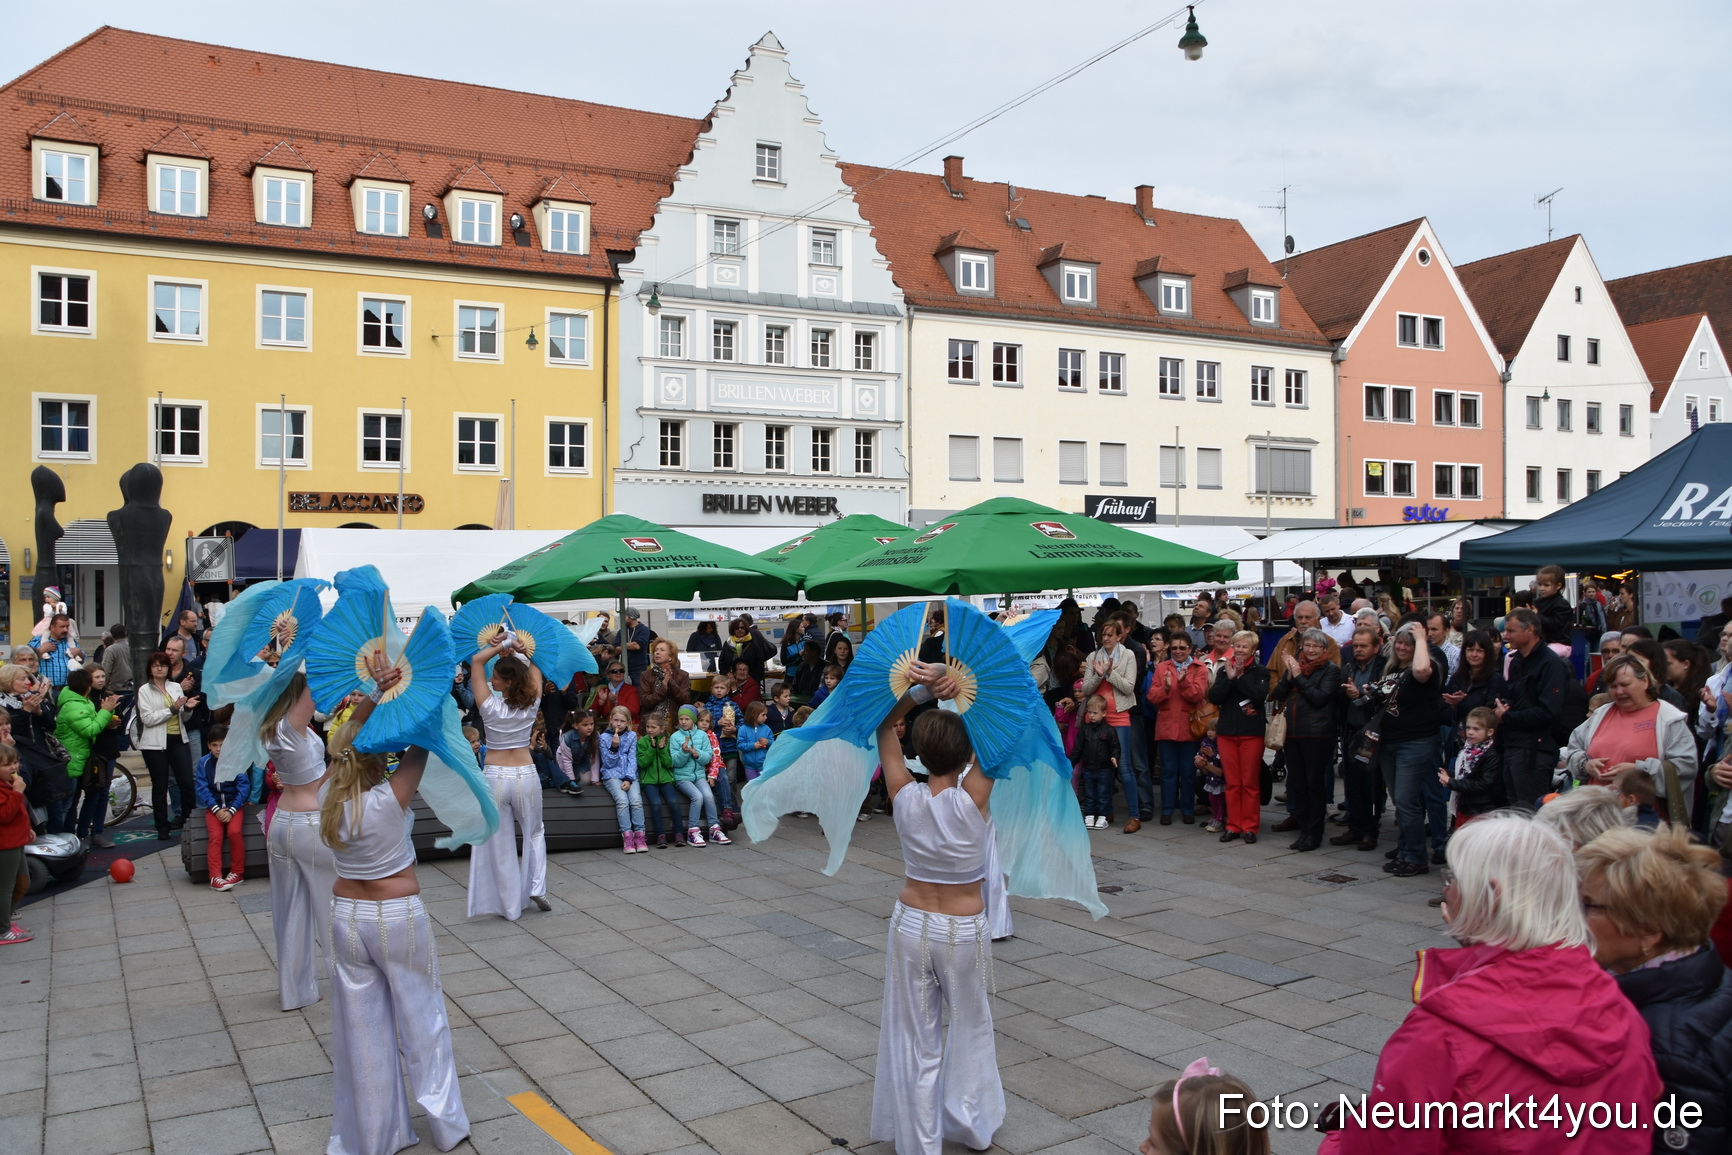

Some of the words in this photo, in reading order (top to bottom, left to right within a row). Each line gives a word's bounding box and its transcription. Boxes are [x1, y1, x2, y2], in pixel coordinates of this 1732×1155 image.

[718, 383, 776, 401] BRILLEN
[778, 387, 831, 404] WEBER
[703, 493, 772, 514] BRILLEN
[775, 495, 840, 515] WEBER
[1402, 503, 1448, 522] sutor
[1652, 520, 1703, 528] Jeden
[1035, 542, 1117, 551] Neumarkter
[1028, 549, 1144, 559] Lammsbräu
[613, 554, 699, 565] Neumarkter
[200, 570, 224, 580] ZONE
